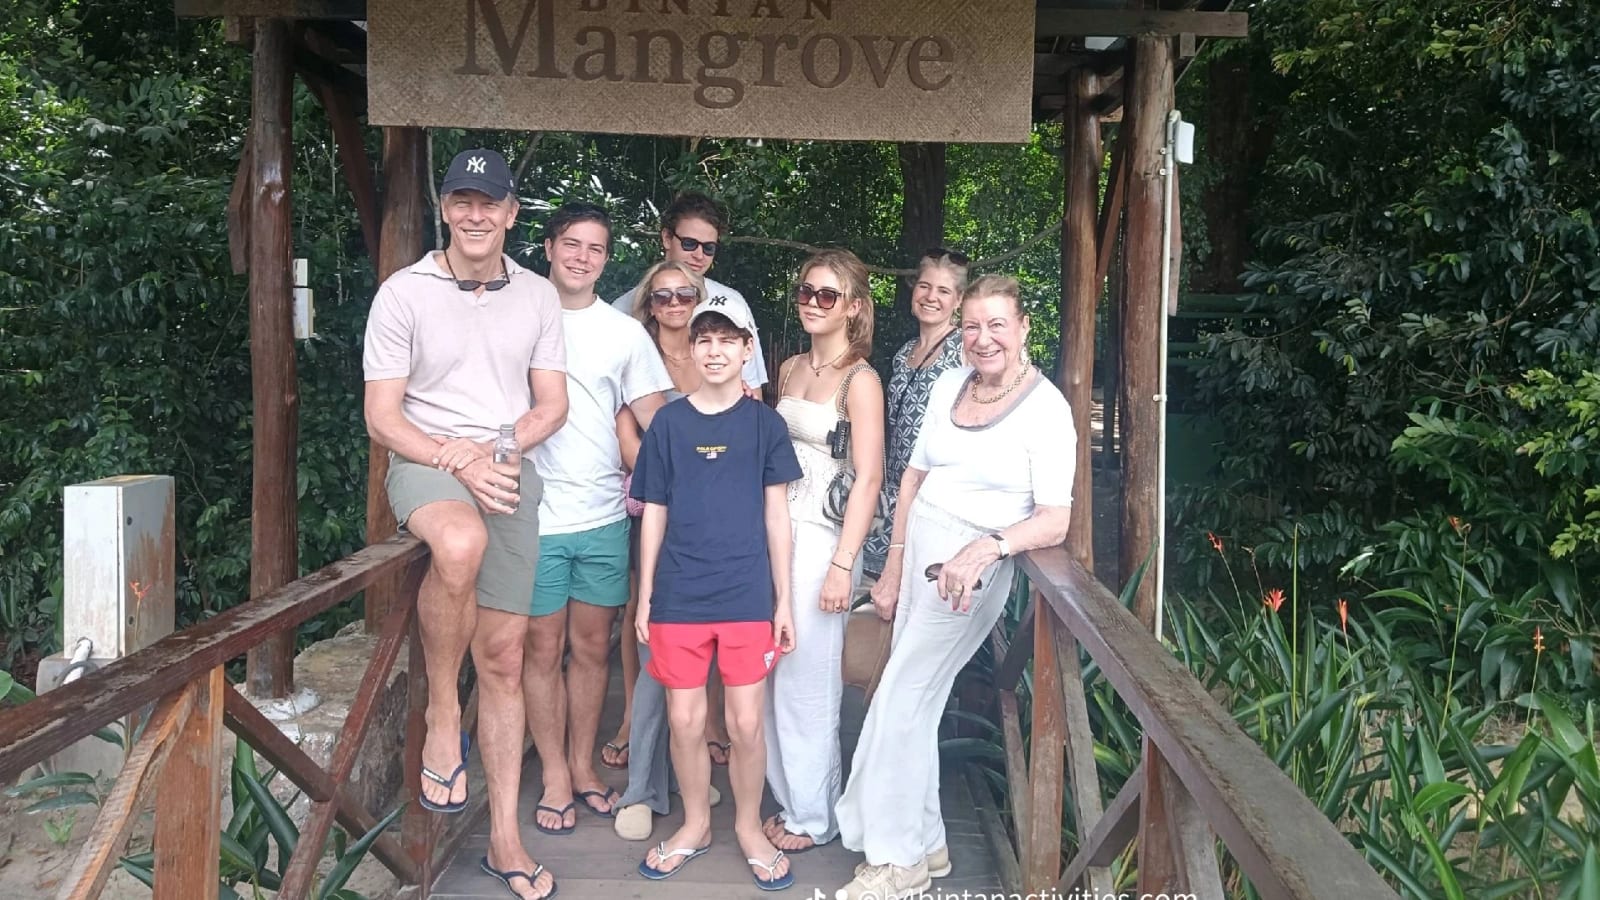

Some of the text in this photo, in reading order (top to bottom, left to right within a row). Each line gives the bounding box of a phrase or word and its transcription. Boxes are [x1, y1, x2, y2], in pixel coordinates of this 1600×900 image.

[453, 0, 954, 109] Mangrove
[466, 156, 487, 174] NY
[709, 295, 728, 306] NY
